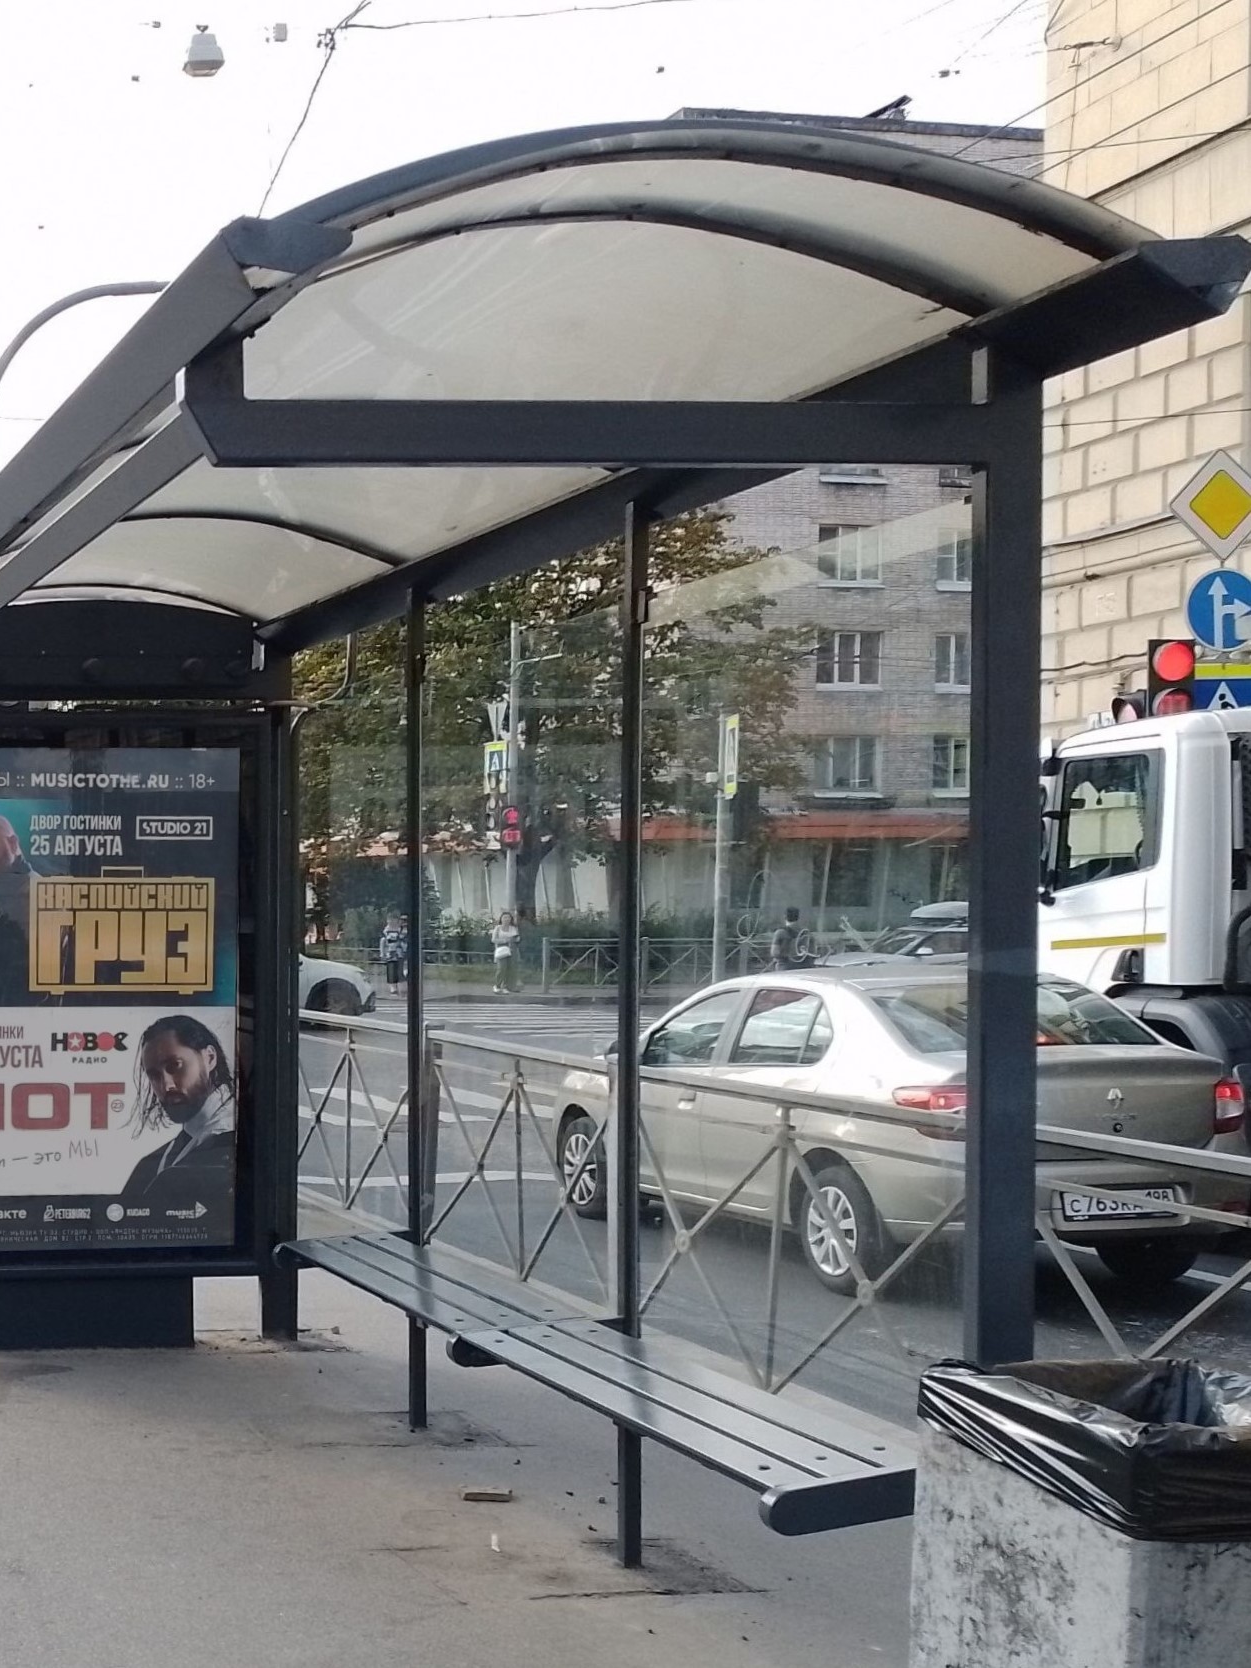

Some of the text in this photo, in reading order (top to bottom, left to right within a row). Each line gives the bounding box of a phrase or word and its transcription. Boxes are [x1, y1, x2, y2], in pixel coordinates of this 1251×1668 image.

[30, 773, 170, 788] MUSICTOTHE.RU
[188, 774, 216, 788] 18+
[30, 815, 122, 831] ДВОР ГОСТИНКИ
[142, 822, 207, 834] STUDIO 21
[30, 835, 123, 856] 25 АВГУСТА
[37, 883, 208, 909] КАСПИЙСКИЙ
[37, 910, 208, 984] ГРУЗ
[72, 1056, 108, 1064] РАДИО
[33, 1151, 62, 1165] это
